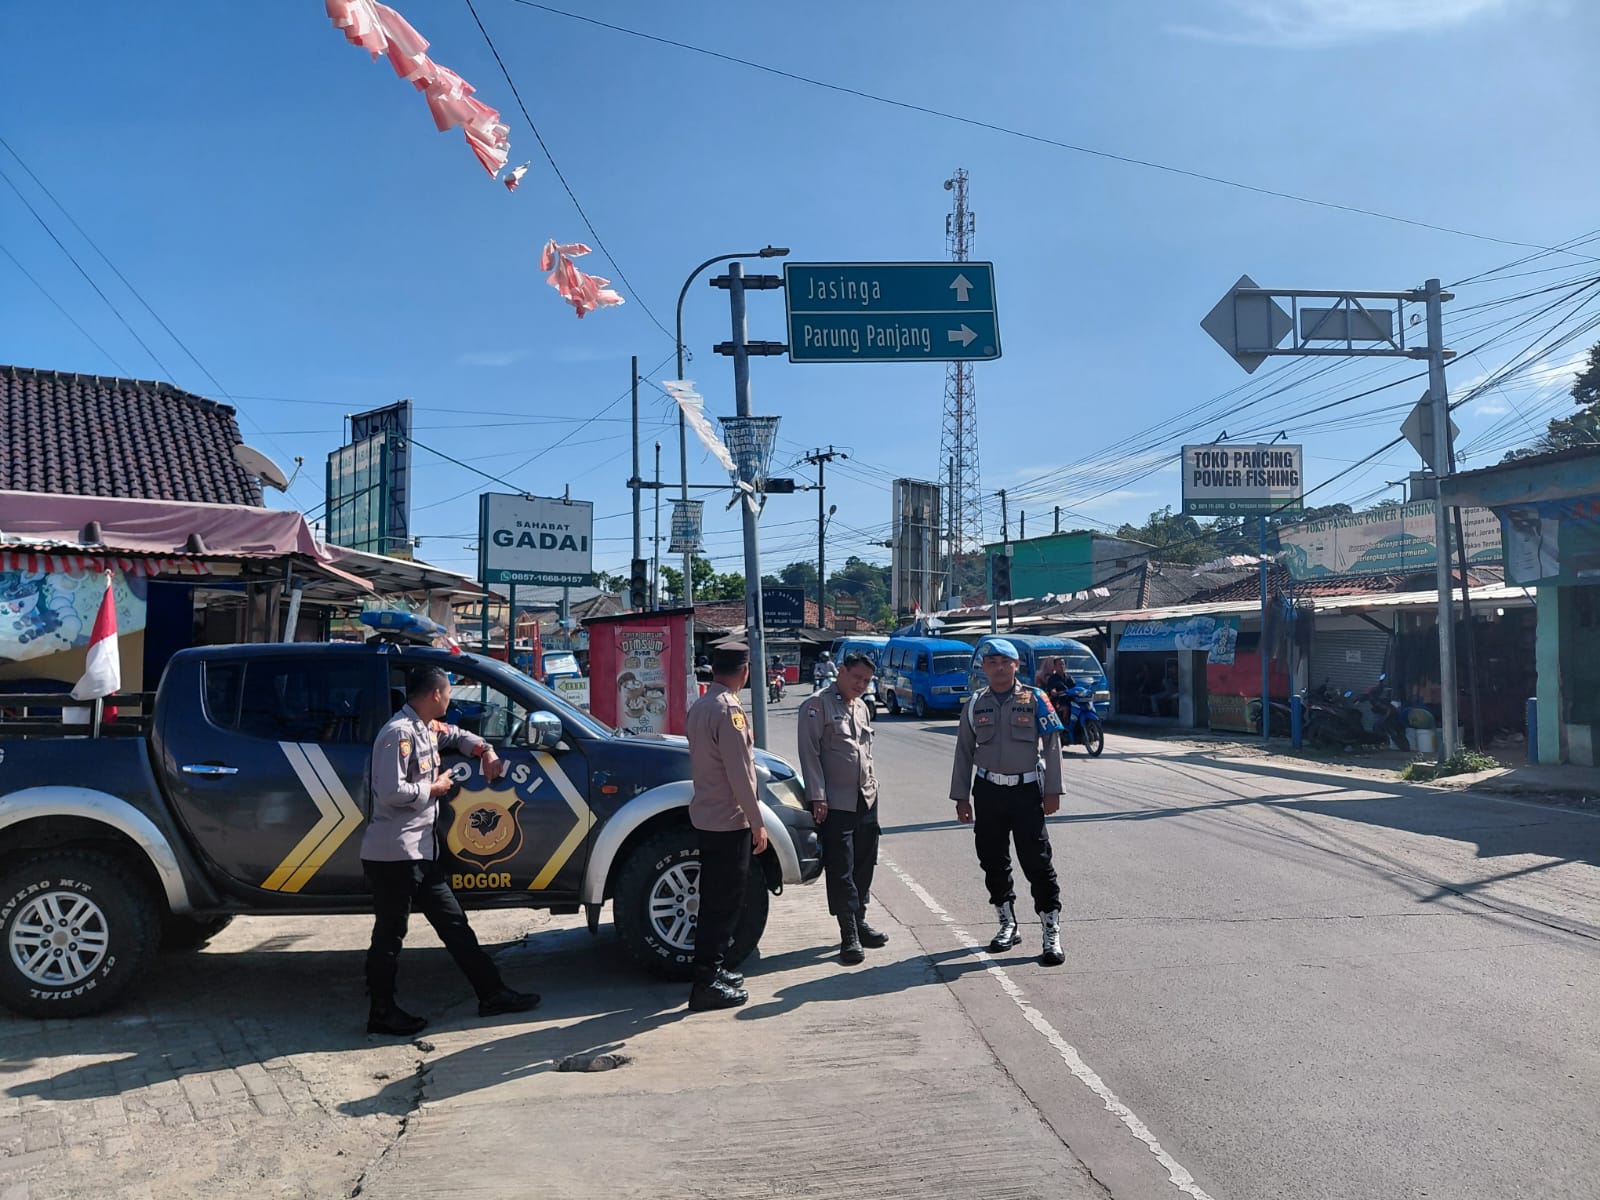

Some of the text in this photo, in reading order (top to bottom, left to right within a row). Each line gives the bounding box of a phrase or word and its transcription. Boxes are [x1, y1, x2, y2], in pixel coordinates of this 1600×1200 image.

[808, 276, 881, 305] Jasinga
[804, 323, 931, 353] Parung Panjang
[1194, 451, 1293, 469] TOKO PANCING
[1193, 469, 1299, 488] POWER FISHING
[516, 520, 571, 531] SAHABAT
[1306, 520, 1326, 534] TOKO
[1328, 514, 1364, 531] PANCING
[1365, 508, 1397, 525] POWER
[492, 529, 588, 552] GADAI
[622, 639, 664, 652] DIMSUM
[59, 878, 92, 893] M/T
[452, 872, 512, 890] BOGOR
[29, 978, 97, 1000] RADIAL
